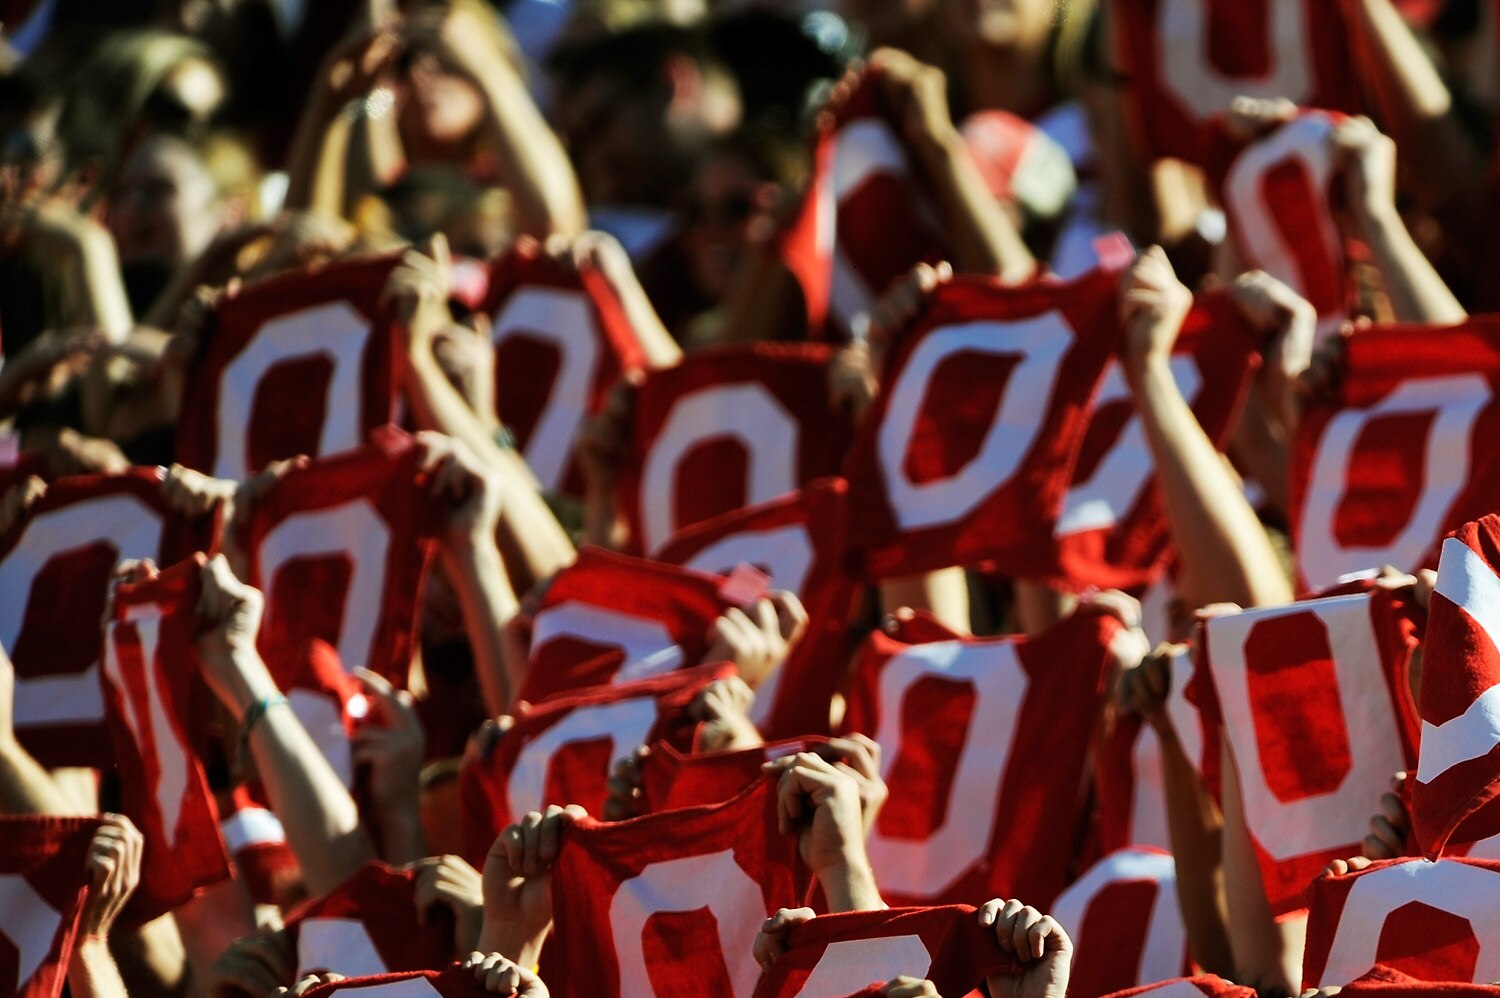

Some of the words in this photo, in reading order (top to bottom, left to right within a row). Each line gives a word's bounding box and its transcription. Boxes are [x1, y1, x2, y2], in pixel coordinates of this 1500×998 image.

[880, 312, 1073, 529] O
[1302, 375, 1491, 593] O
[868, 642, 1029, 896] O
[1207, 594, 1405, 860] O
